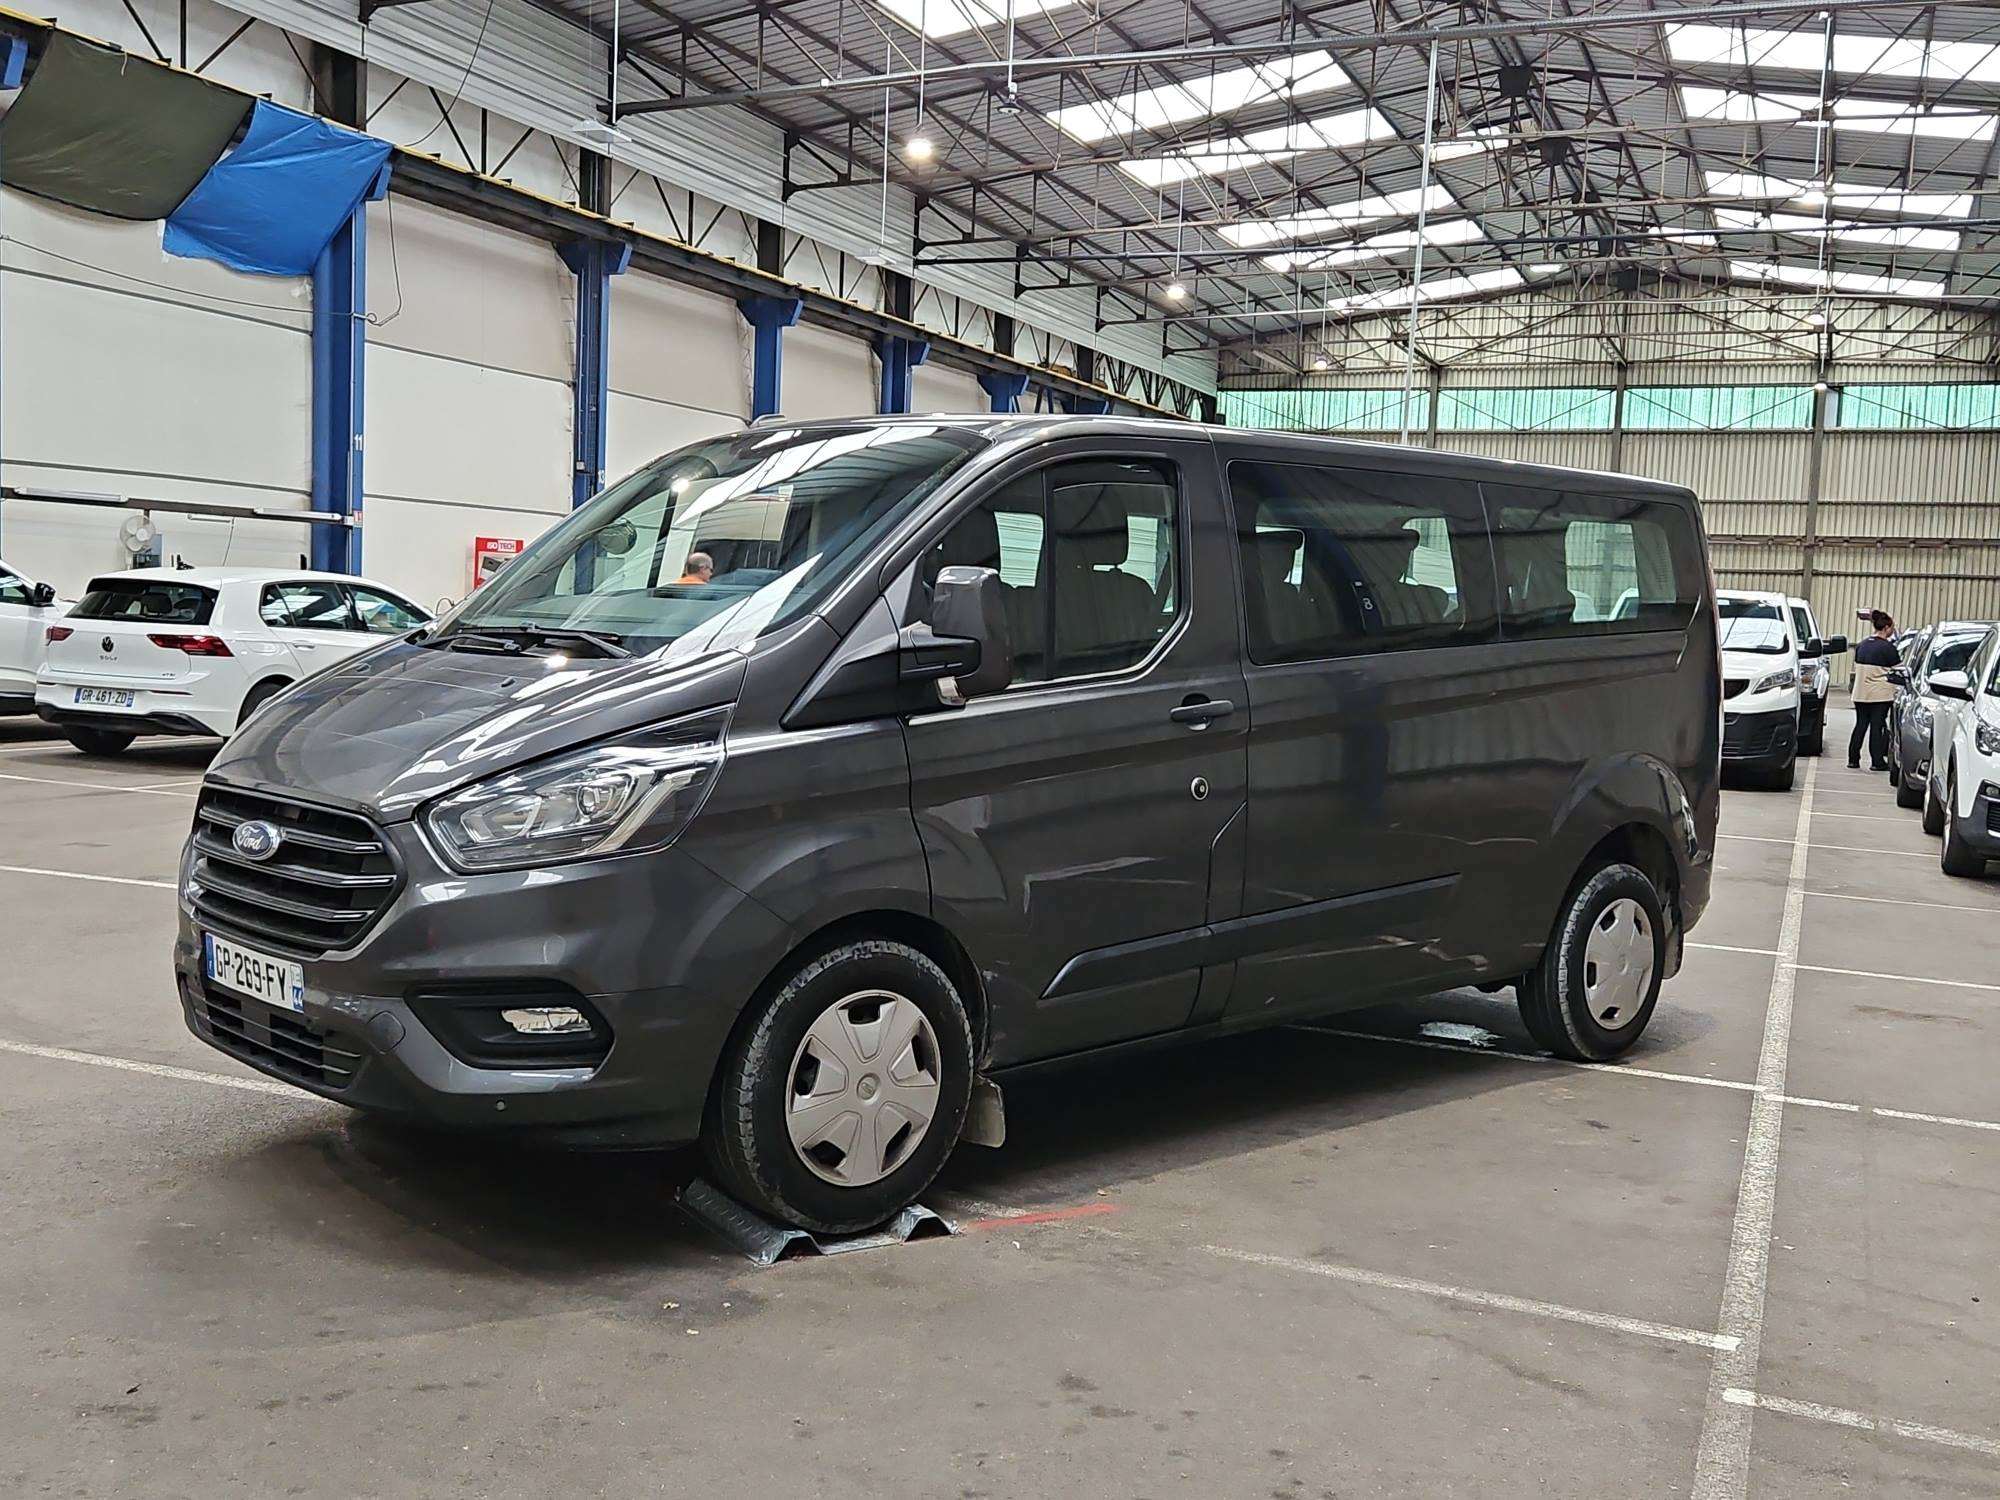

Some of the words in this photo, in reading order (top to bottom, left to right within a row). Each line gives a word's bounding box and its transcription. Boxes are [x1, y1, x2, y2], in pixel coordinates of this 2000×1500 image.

[354, 434, 363, 451] 11
[81, 688, 128, 704] GR-461-ZD
[239, 825, 264, 850] Ford
[215, 943, 287, 1001] GP-269-FY
